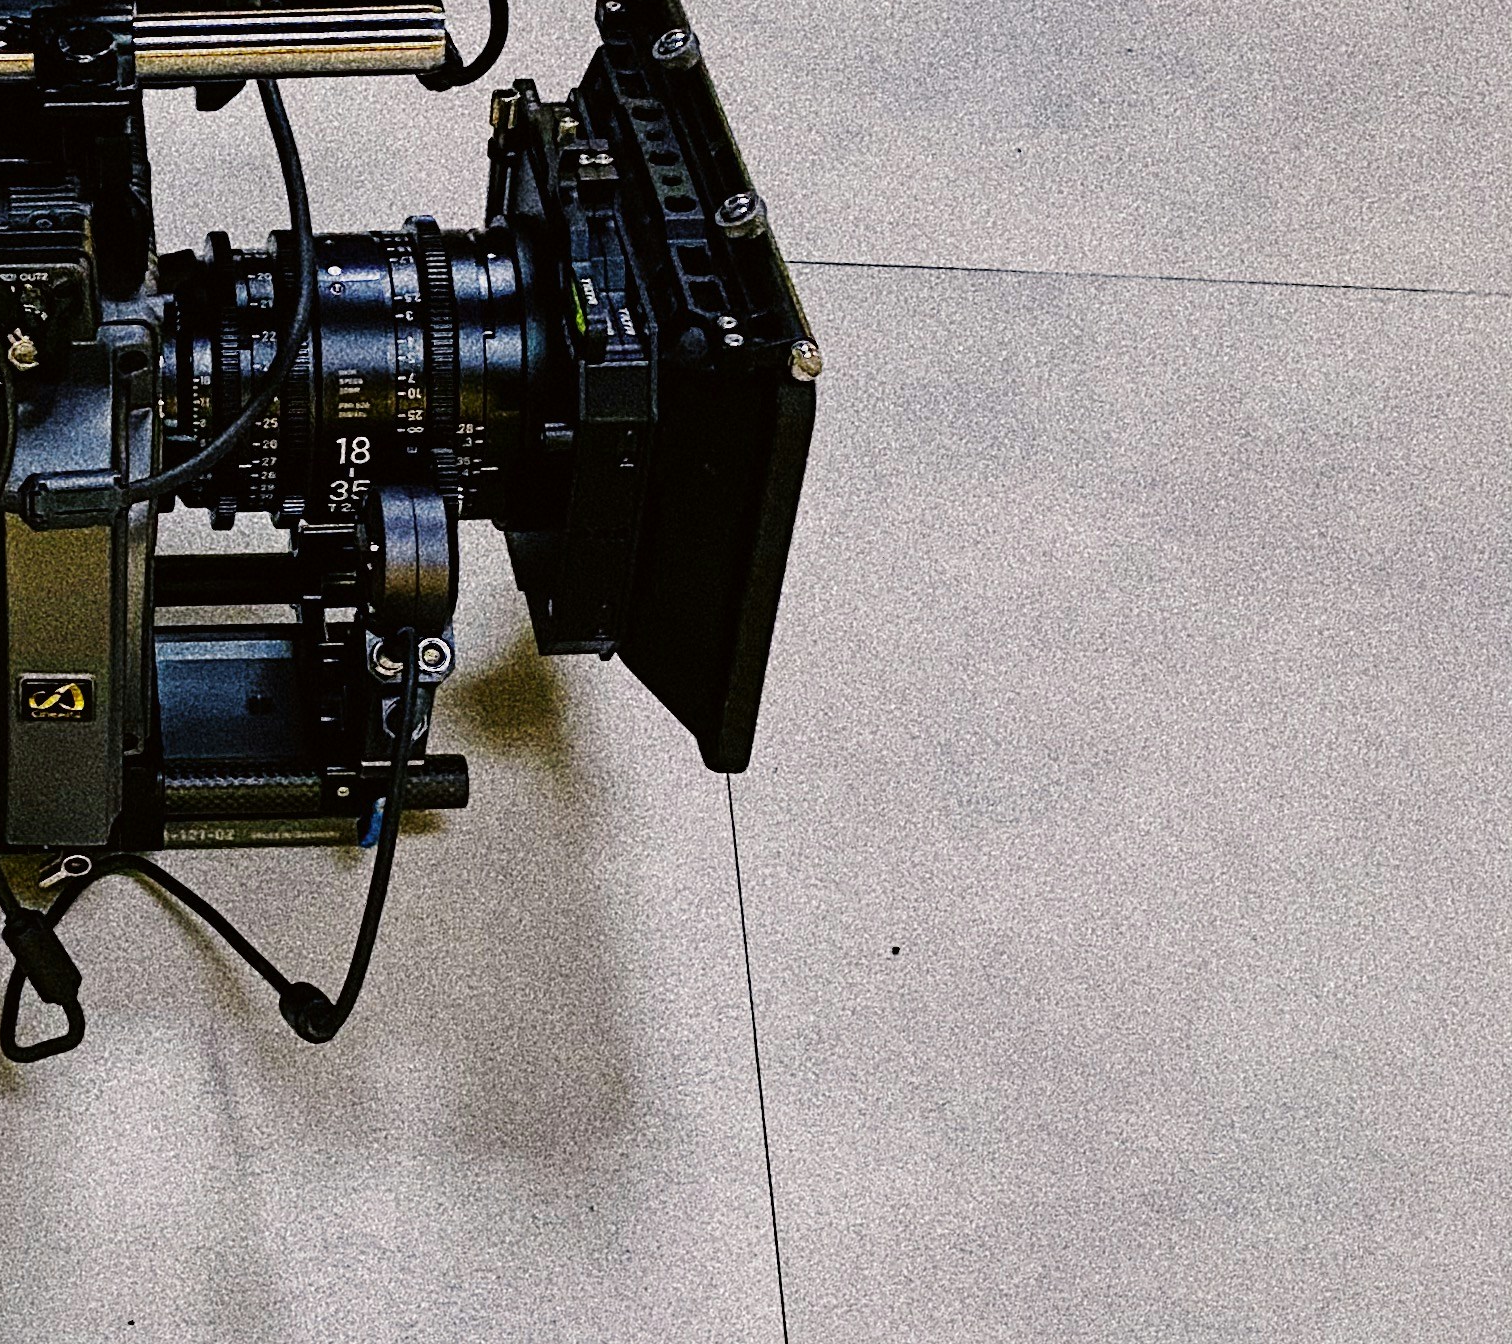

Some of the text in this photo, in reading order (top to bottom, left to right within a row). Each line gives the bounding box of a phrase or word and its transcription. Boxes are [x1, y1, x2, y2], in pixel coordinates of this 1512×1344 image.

[261, 330, 277, 342] 22
[407, 387, 422, 399] 10
[407, 409, 424, 421] 25
[262, 417, 279, 429] 25
[336, 436, 371, 465] 18
[329, 479, 371, 501] 35
